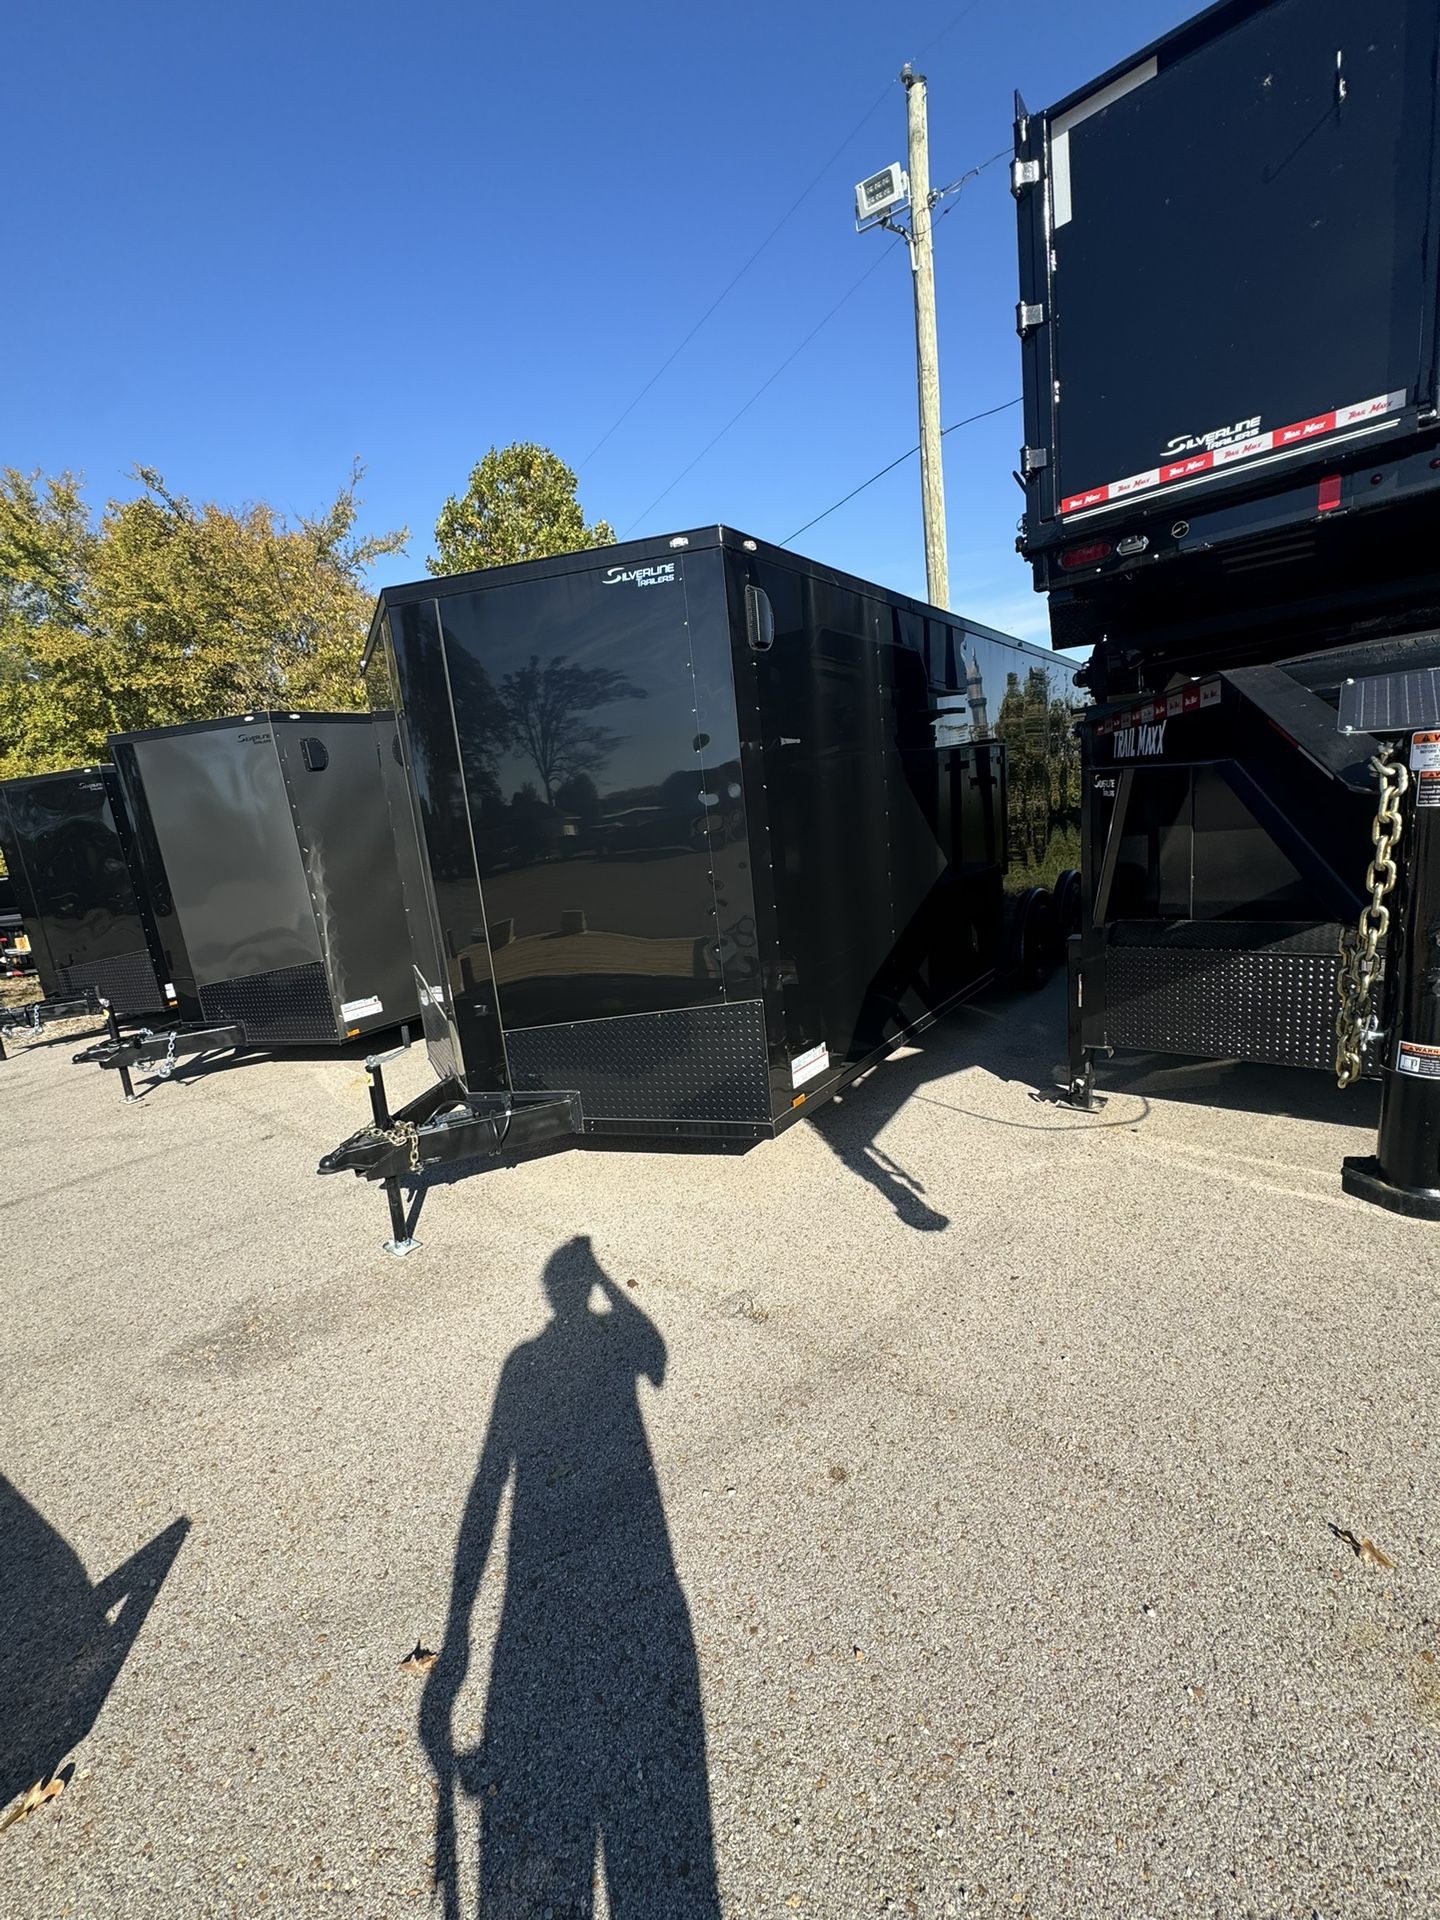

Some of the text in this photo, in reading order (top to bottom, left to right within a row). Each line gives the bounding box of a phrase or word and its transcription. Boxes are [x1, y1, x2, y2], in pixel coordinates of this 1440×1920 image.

[1160, 415, 1262, 456] SILVERLINE
[1206, 427, 1260, 451] TRAILERS
[602, 562, 675, 584] SILVERLINE
[636, 573, 675, 588] TRAILERS
[1113, 720, 1167, 759] TRAIL MAXX
[1415, 1047, 1440, 1055] WARN
